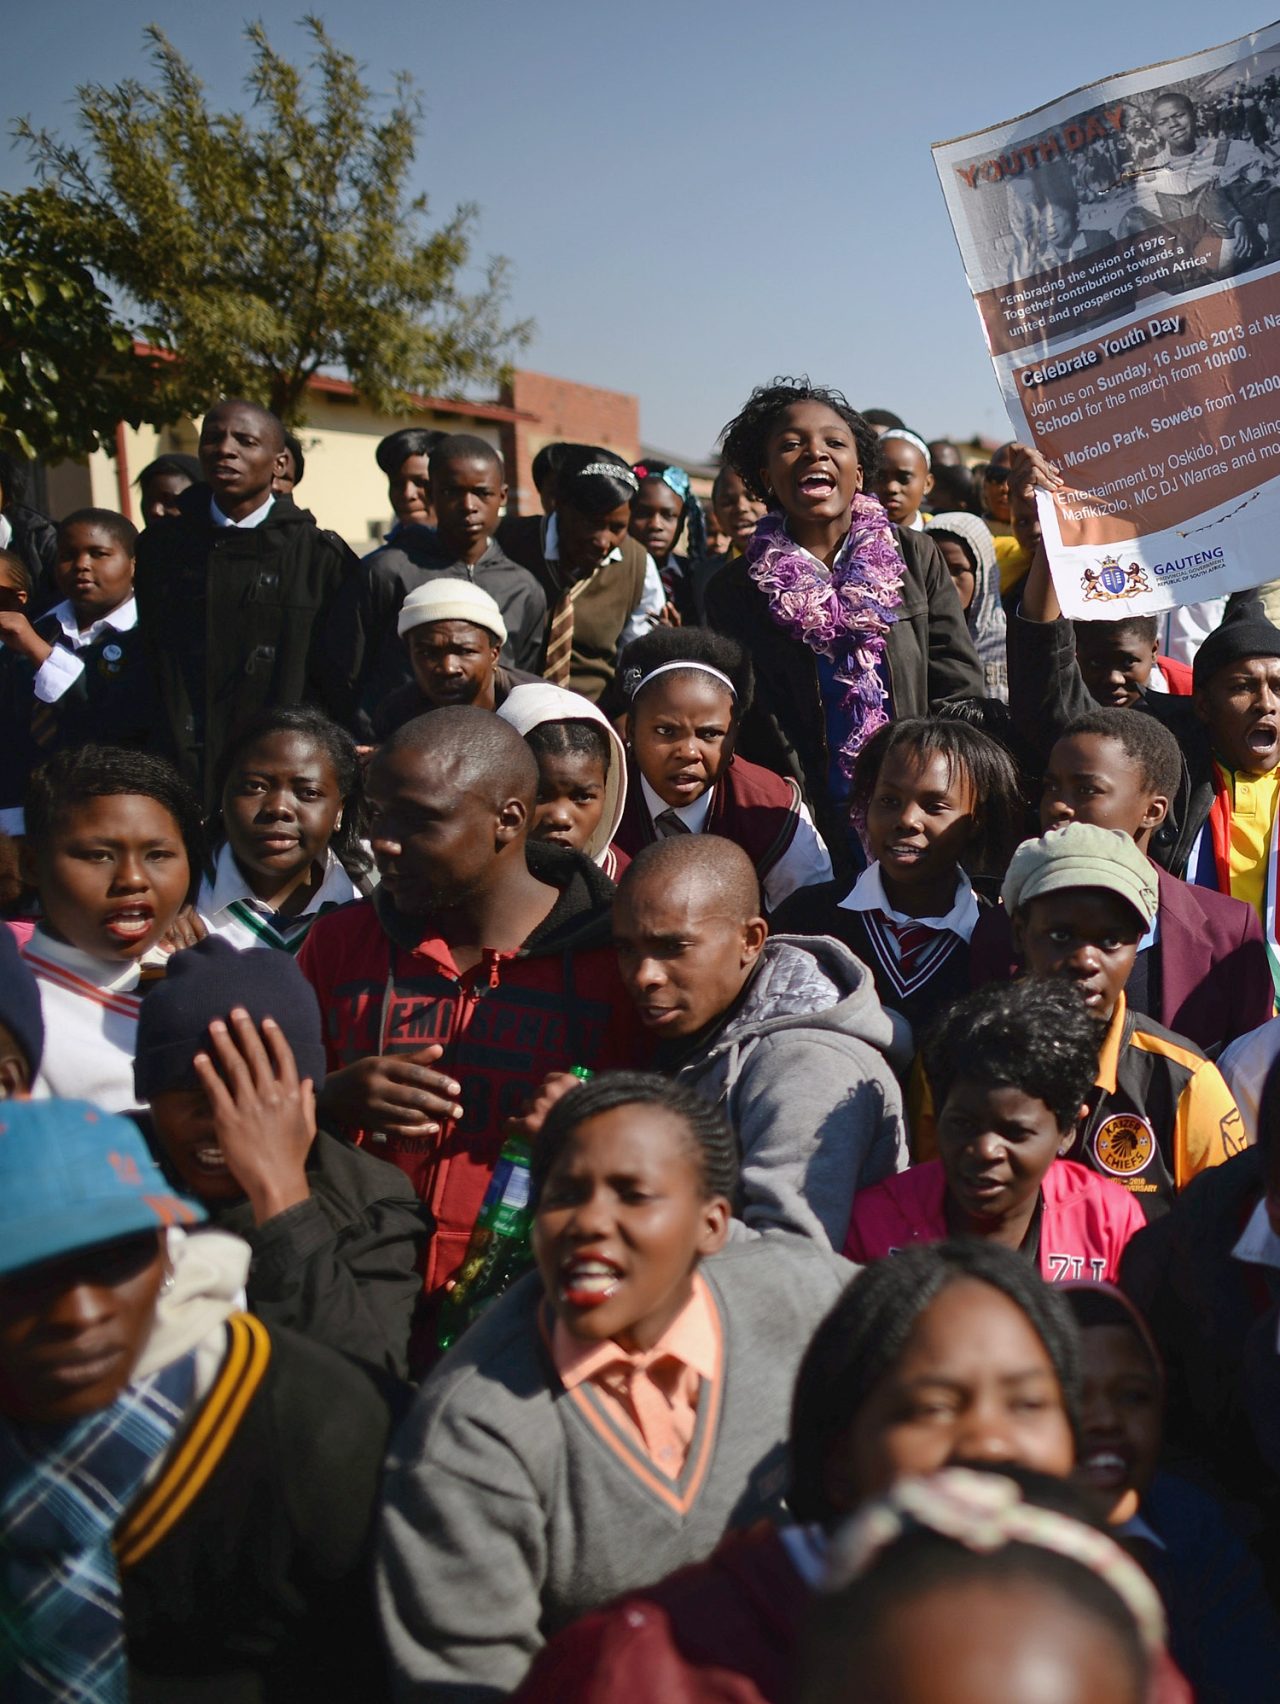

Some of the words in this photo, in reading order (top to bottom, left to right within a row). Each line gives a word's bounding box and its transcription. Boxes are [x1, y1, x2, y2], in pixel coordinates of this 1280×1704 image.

[955, 133, 1061, 188] YOUTH
[1063, 104, 1125, 151] DAY
[1003, 297, 1055, 321] Together
[1057, 269, 1125, 303] contribution
[1126, 249, 1174, 273] towards
[1177, 245, 1184, 255] a
[1067, 270, 1086, 284] the
[1088, 255, 1121, 274] vision
[1123, 246, 1136, 259] of
[1138, 235, 1166, 253] 1976
[1009, 313, 1046, 337] united
[1048, 305, 1070, 324] and
[1072, 282, 1134, 316] prosperous
[1136, 267, 1169, 287] South
[1021, 350, 1097, 387] Celebrate
[1098, 327, 1146, 357] Youth
[1148, 315, 1180, 337] Day
[1031, 397, 1057, 417] Join
[1060, 393, 1076, 408] us
[1078, 385, 1095, 399] on
[1097, 361, 1151, 391] Sunday,
[1153, 351, 1171, 367] 16
[1174, 339, 1208, 360] June
[1210, 325, 1245, 347] 2013
[1248, 320, 1262, 335] at
[1035, 407, 1083, 436] School
[1085, 400, 1102, 417] for
[1105, 393, 1126, 409] the
[1129, 374, 1168, 400] march
[1171, 362, 1202, 383] from
[1204, 345, 1252, 370] 10h00.
[1064, 441, 1111, 468] Mofolo
[1112, 426, 1149, 449] Park,
[1151, 405, 1203, 433] Soweto
[1205, 393, 1237, 413] from
[1056, 467, 1148, 505] Entertainment
[1149, 463, 1165, 478] by
[1168, 443, 1219, 470] Oskido,
[1219, 433, 1236, 450] Dr
[1062, 497, 1132, 521] Mafikizolo,
[1134, 486, 1158, 505] MC
[1160, 477, 1179, 496] DJ
[1180, 462, 1228, 488] Warras
[1232, 451, 1257, 469] and
[1153, 546, 1224, 575] GAUTENG
[1156, 570, 1187, 582] PROVINCIAL
[1188, 558, 1225, 574] GOVERNMENT
[1157, 578, 1182, 587] REPUBLIC
[1189, 570, 1207, 579] SOUTH
[1208, 563, 1226, 573] AFRICA
[1104, 1120, 1141, 1137] KAIZER
[1106, 1151, 1144, 1169] CHIEFS
